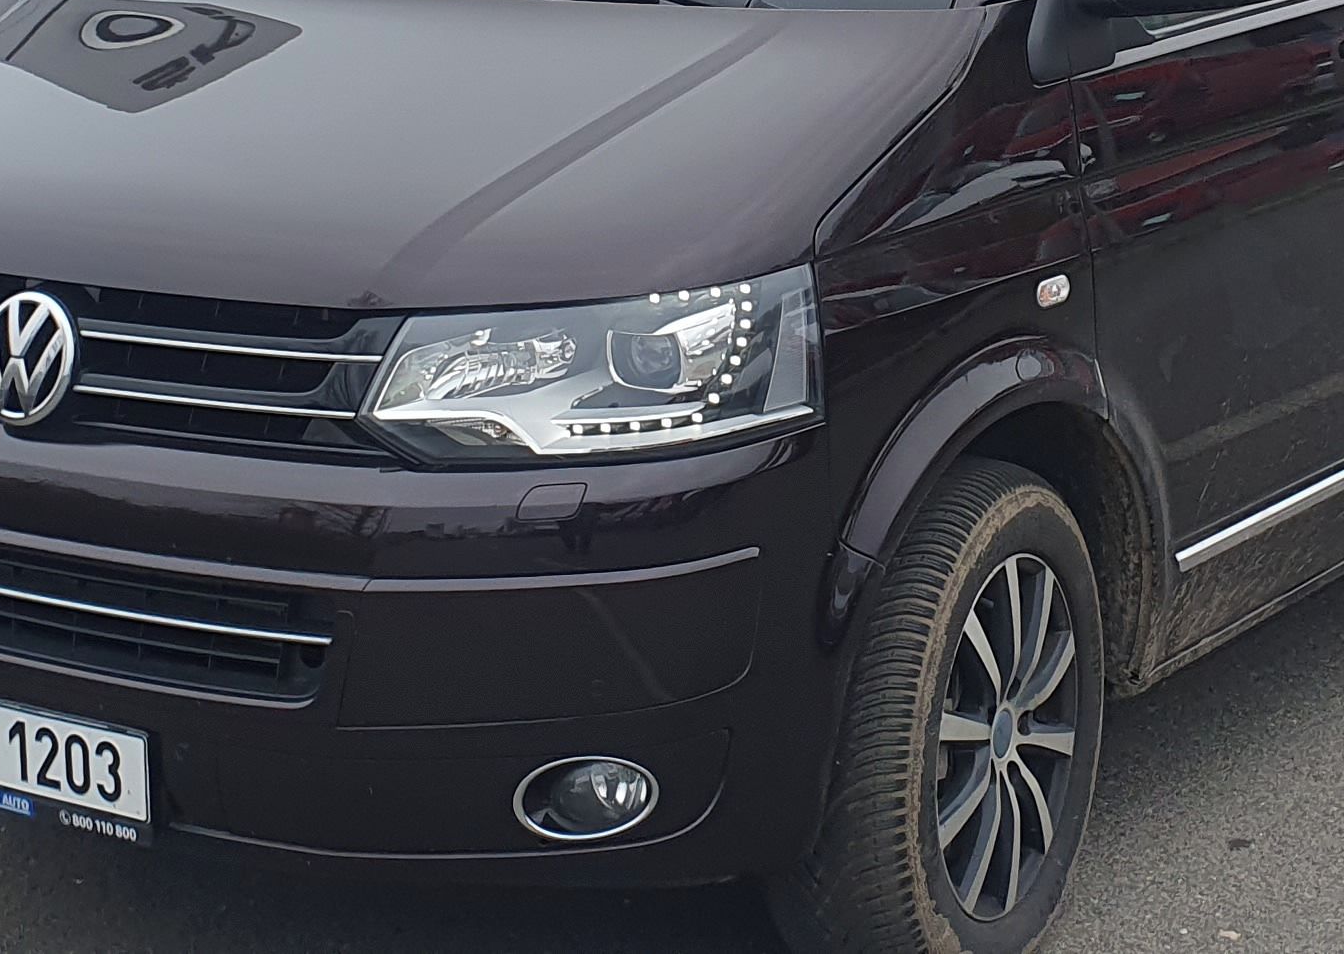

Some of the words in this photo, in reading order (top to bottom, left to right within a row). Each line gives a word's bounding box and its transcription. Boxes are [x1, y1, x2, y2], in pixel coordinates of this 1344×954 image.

[8, 719, 123, 803] 1203
[2, 794, 31, 812] AUTO
[71, 812, 94, 830] 800
[94, 819, 114, 835] 110
[115, 825, 138, 842] 800
